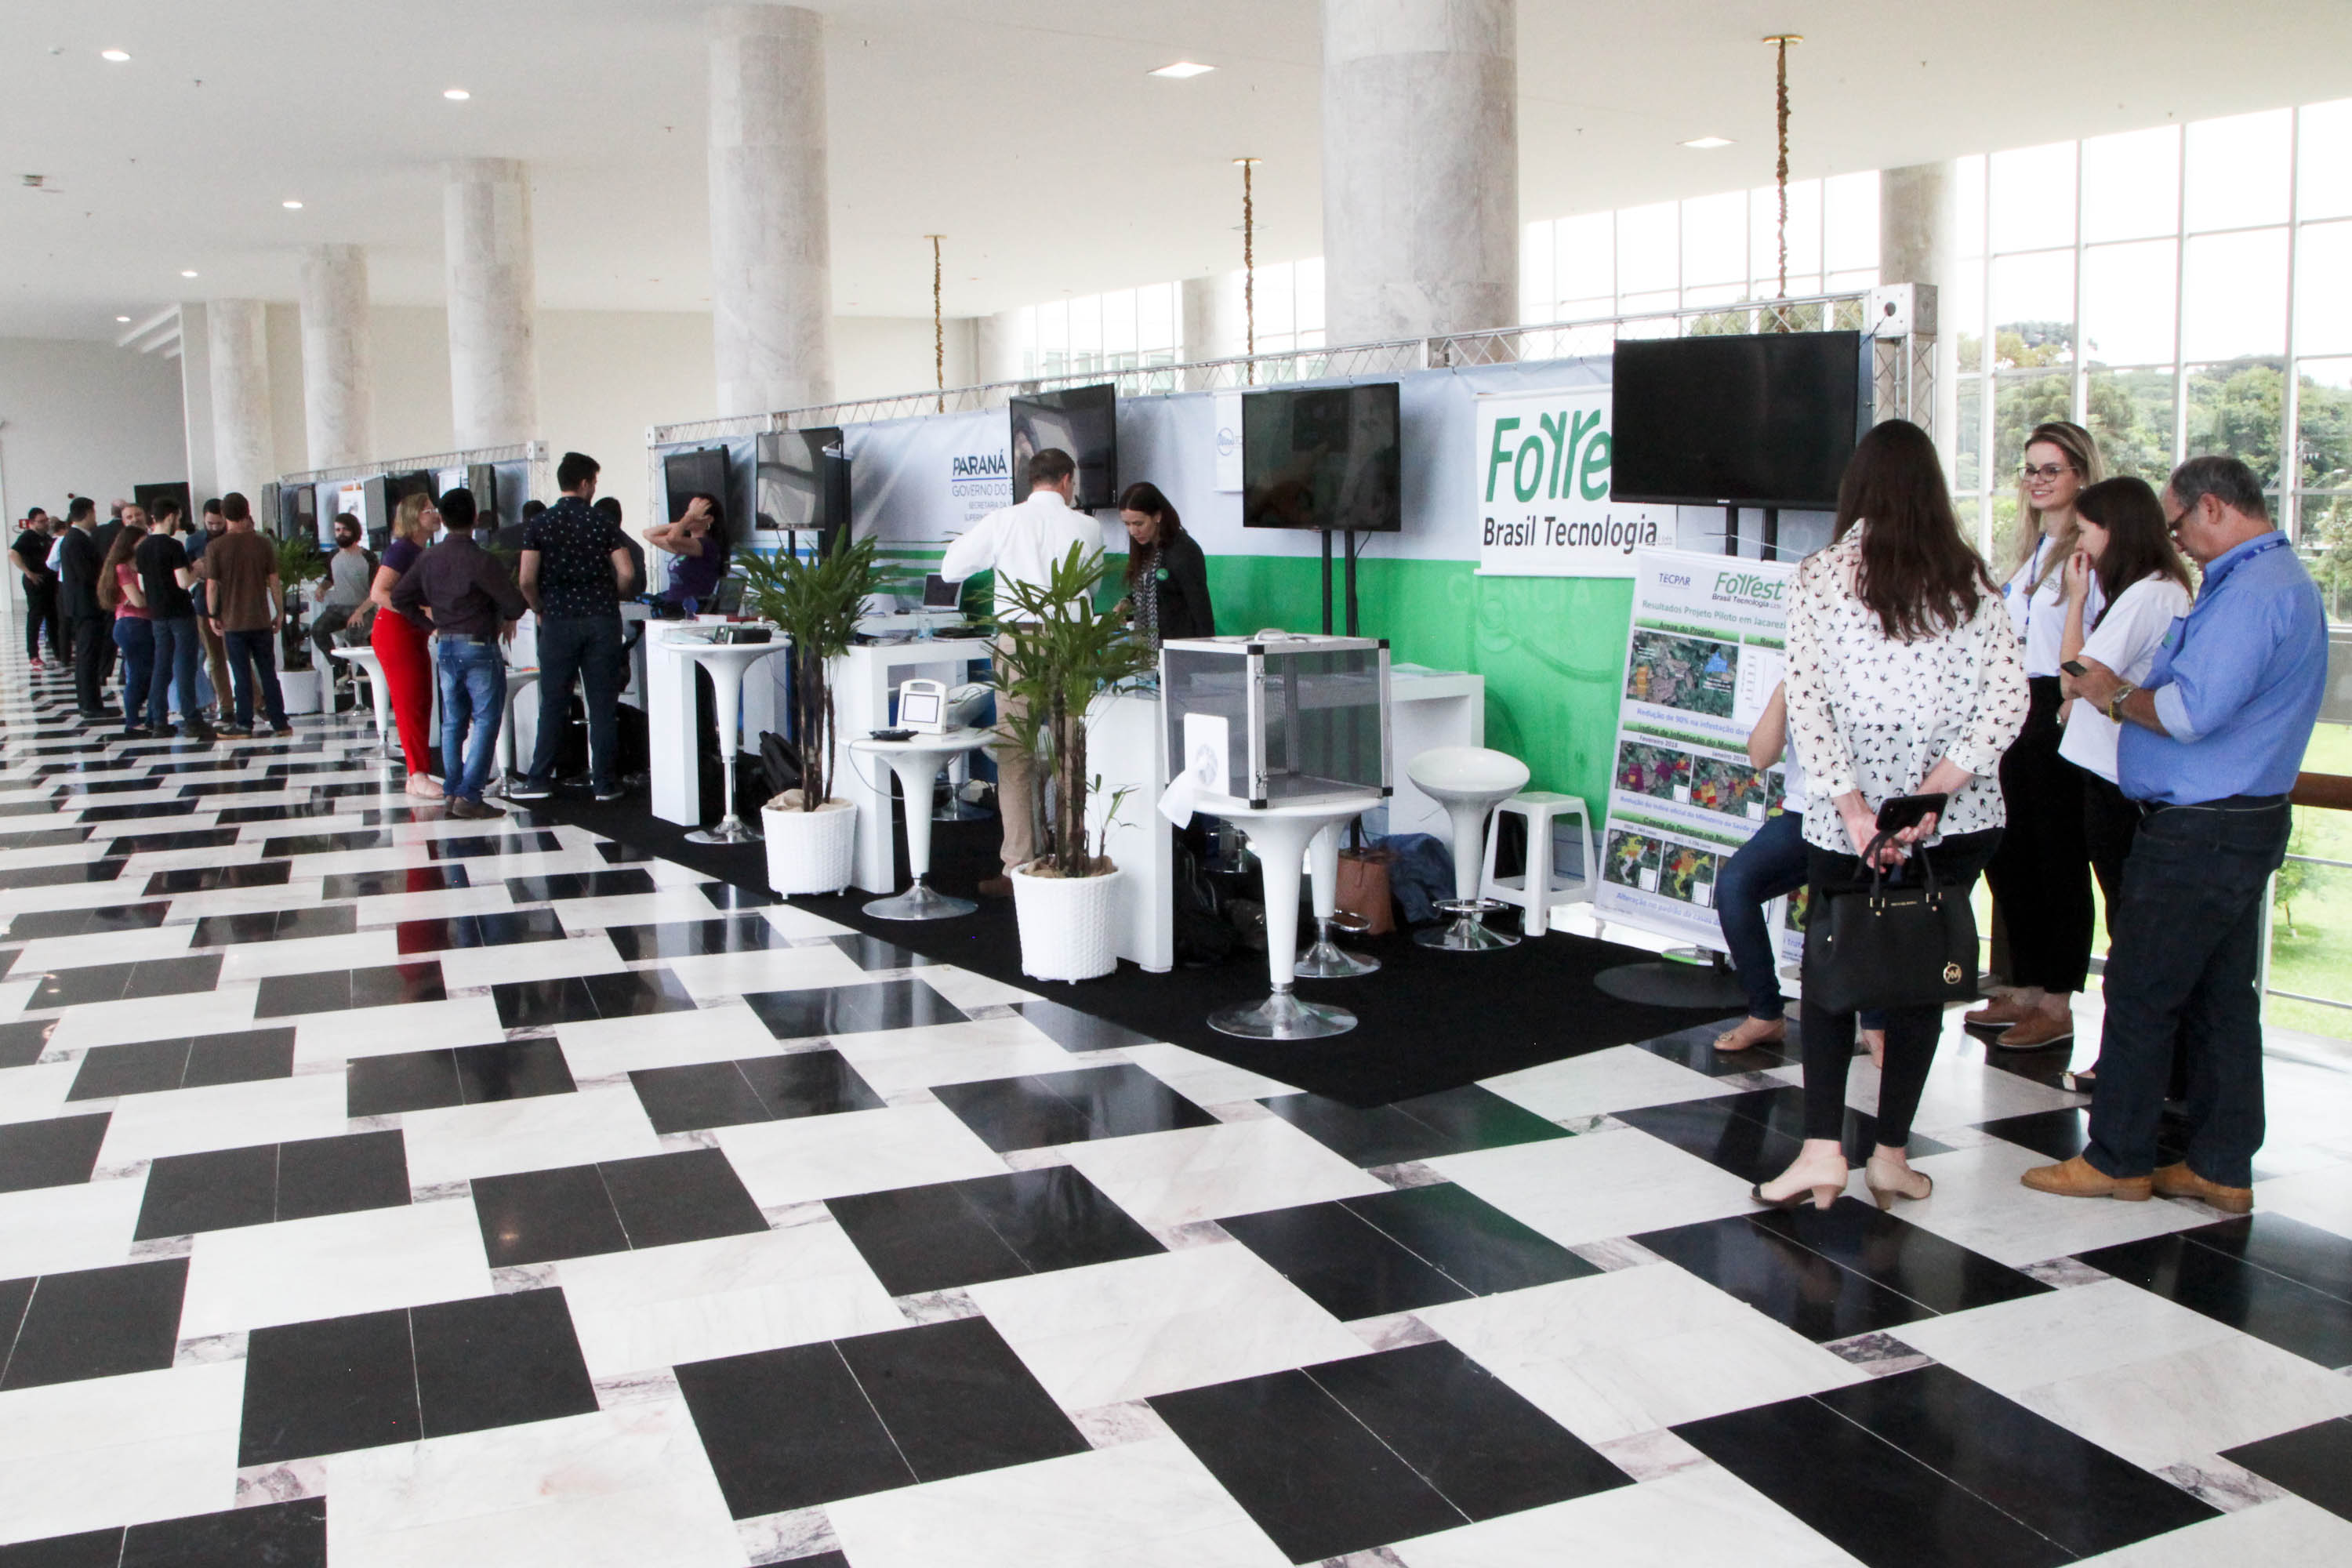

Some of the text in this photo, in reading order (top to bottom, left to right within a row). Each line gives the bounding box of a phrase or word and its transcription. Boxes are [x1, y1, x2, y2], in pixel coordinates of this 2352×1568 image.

[953, 448, 1007, 476] PARANÁ
[952, 484, 993, 496] GOVERNO
[994, 483, 1007, 495] DO
[1483, 515, 1537, 546] Brasil
[1544, 514, 1657, 554] Tecnologia
[1658, 572, 1691, 586] TECPAR
[1711, 593, 1731, 602] Brasil
[1733, 596, 1769, 608] Tecnologia
[1642, 600, 1682, 614] Resultados
[1683, 606, 1712, 619] Projeto
[1714, 610, 1737, 622] Piloto
